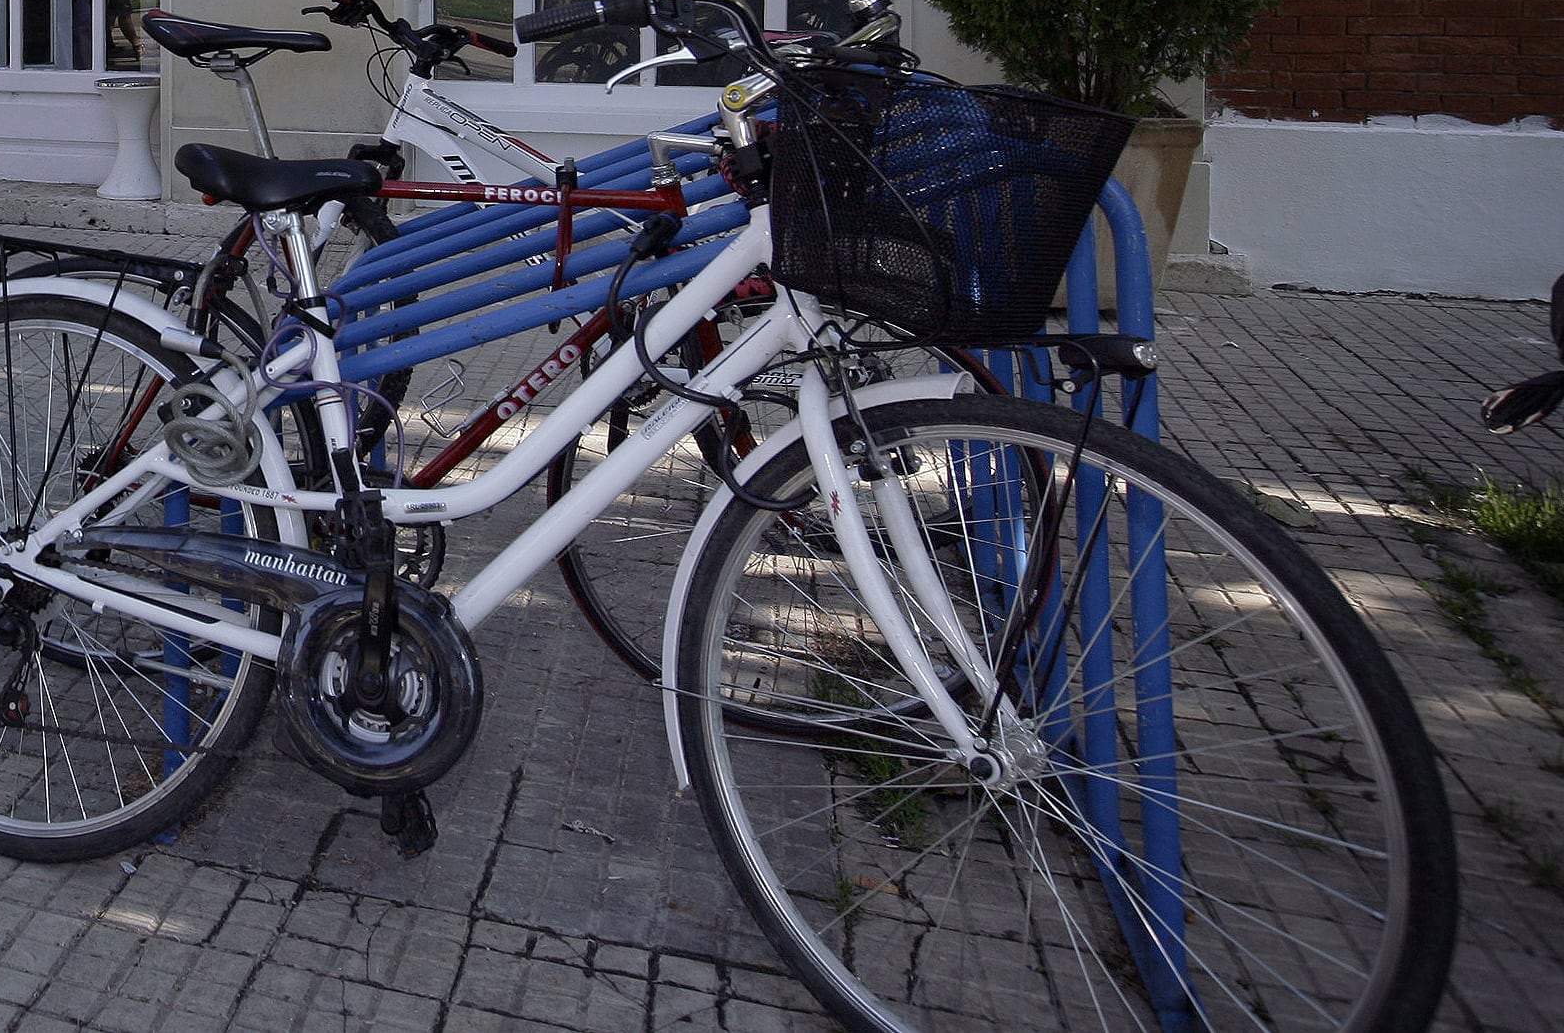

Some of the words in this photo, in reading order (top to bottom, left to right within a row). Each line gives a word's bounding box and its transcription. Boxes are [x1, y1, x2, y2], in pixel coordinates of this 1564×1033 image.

[450, 112, 513, 151] OPEN
[497, 345, 581, 420] OTERO
[262, 489, 280, 500] 1887
[244, 549, 348, 586] manhattan
